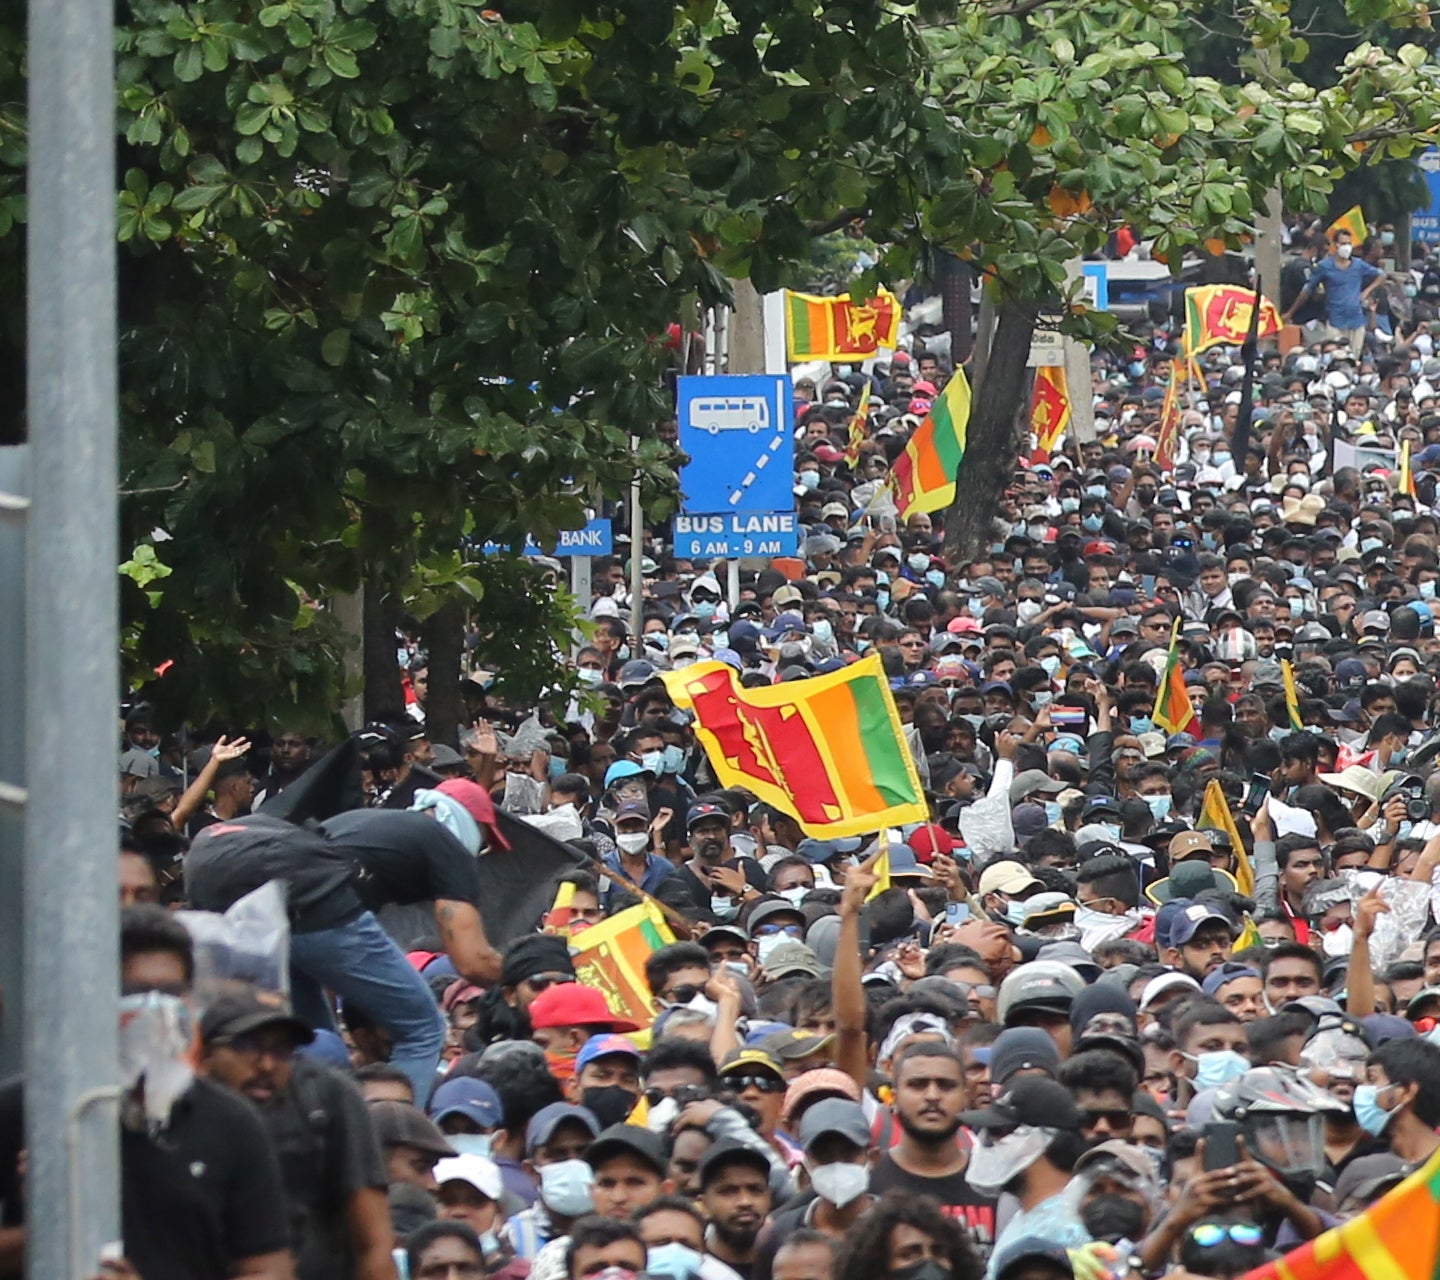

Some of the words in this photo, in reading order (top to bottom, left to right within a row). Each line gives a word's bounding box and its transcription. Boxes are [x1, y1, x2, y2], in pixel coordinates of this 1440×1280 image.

[676, 516, 724, 533] BUS
[732, 516, 794, 533] LANE
[561, 530, 602, 547] BANK
[691, 540, 701, 554] 6
[705, 542, 728, 554] AM
[743, 540, 753, 554] 9
[758, 541, 781, 553] AM
